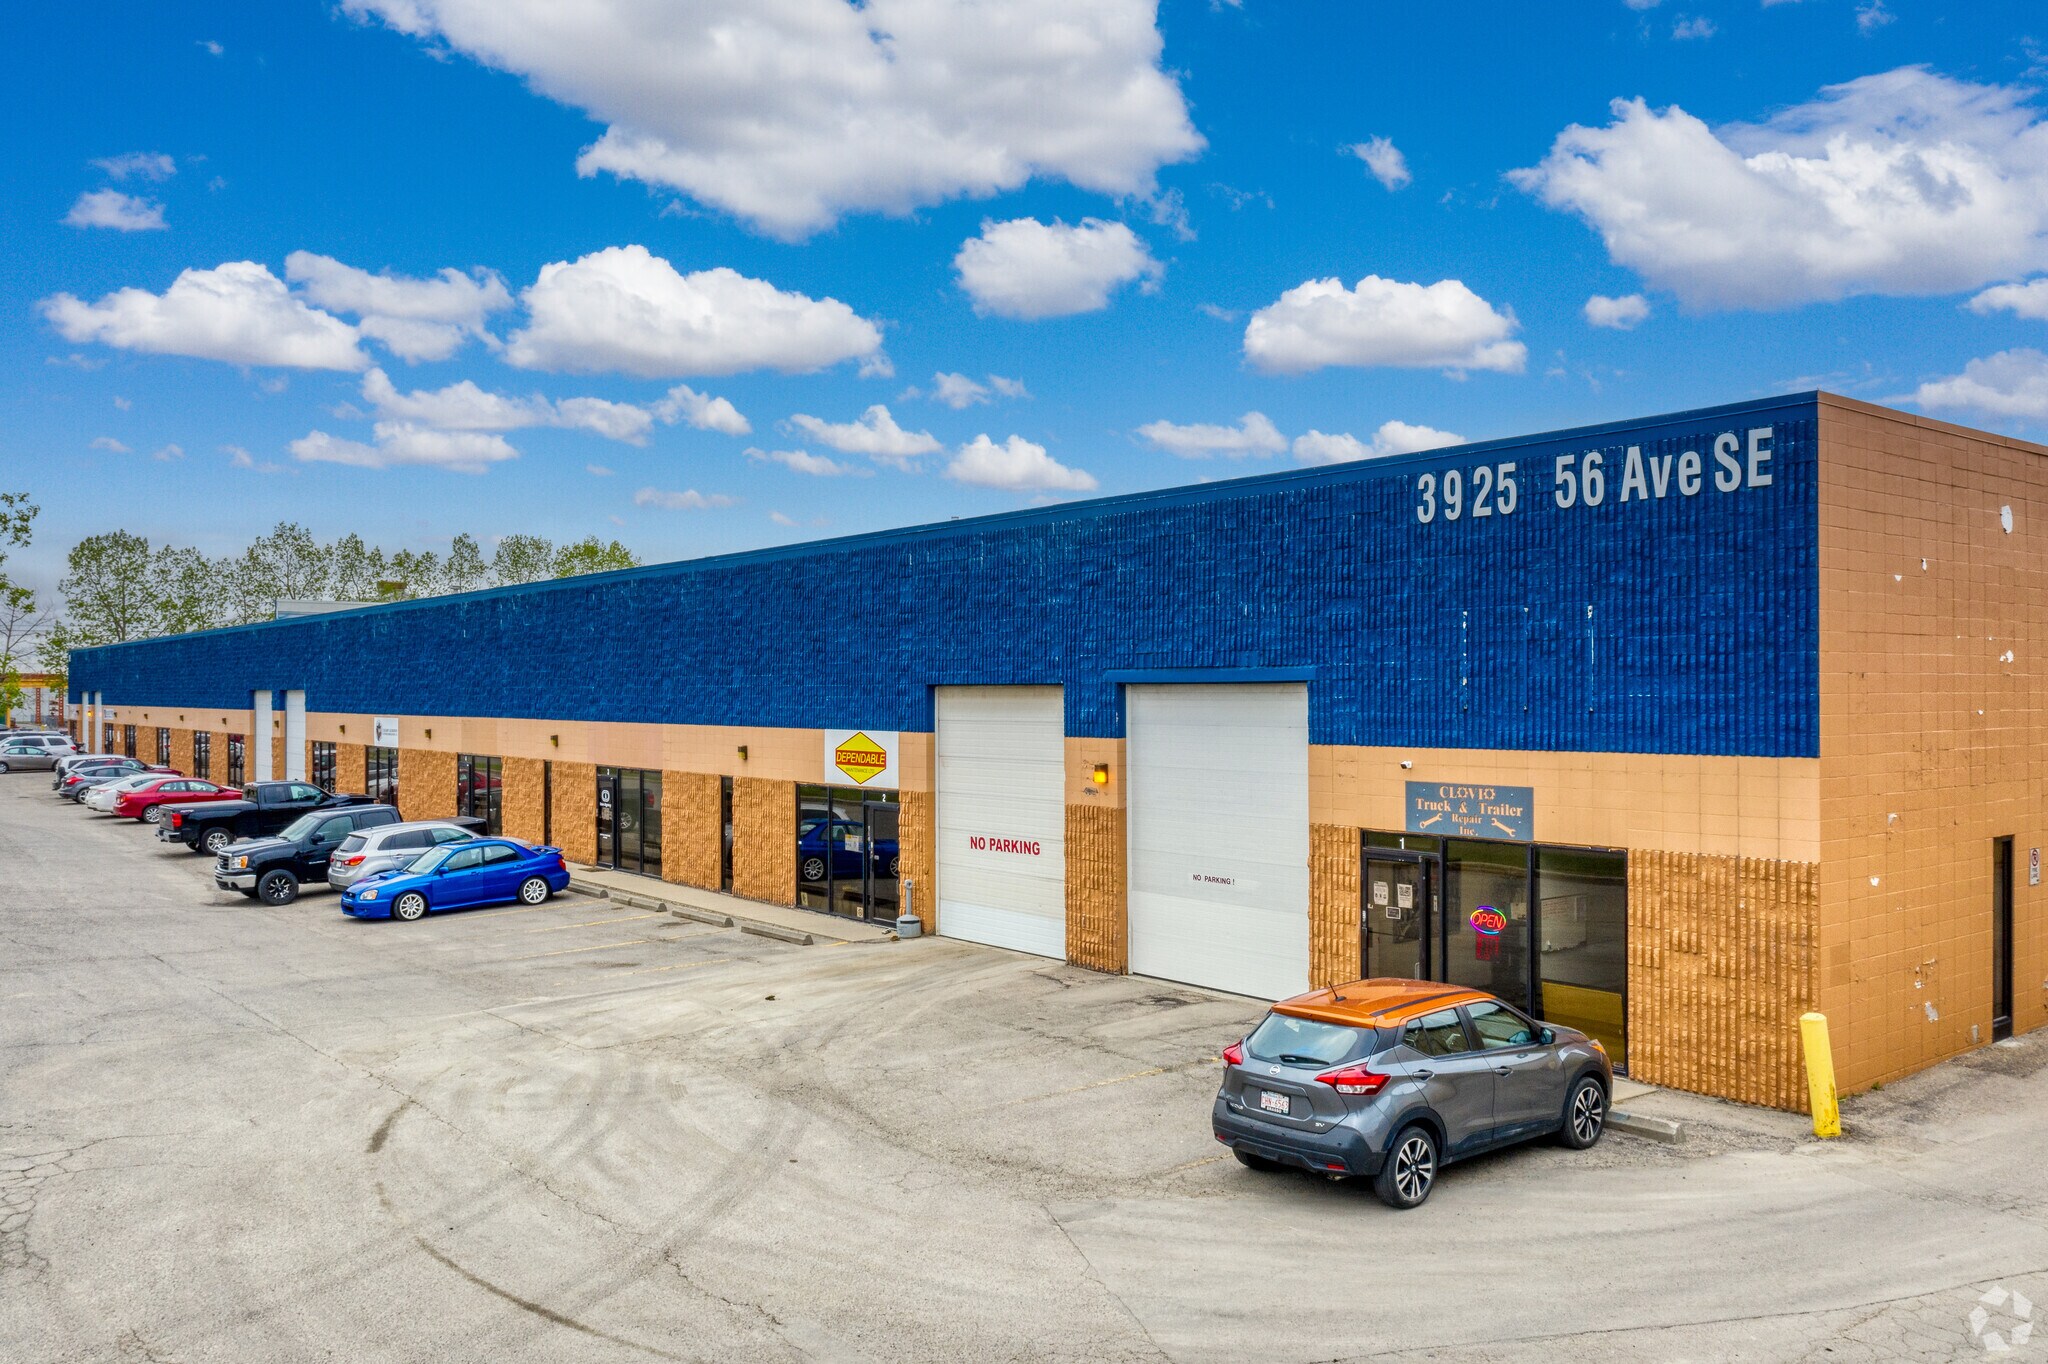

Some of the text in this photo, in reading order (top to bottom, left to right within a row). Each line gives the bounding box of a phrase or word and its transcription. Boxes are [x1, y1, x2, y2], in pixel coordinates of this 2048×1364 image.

[1555, 452, 1605, 508] 56
[1620, 446, 1702, 502] Ave
[1713, 427, 1773, 492] SE
[836, 752, 885, 764] DEPENDABLE
[882, 793, 887, 802] 2
[1439, 785, 1496, 800] CLOVIO
[1416, 798, 1523, 817] Truck & Trailer
[1451, 813, 1482, 825] Repair
[1459, 826, 1479, 836] Inc.
[970, 836, 1041, 856] NO PARKING
[1399, 837, 1405, 850] 1
[1473, 912, 1503, 928] OPEN
